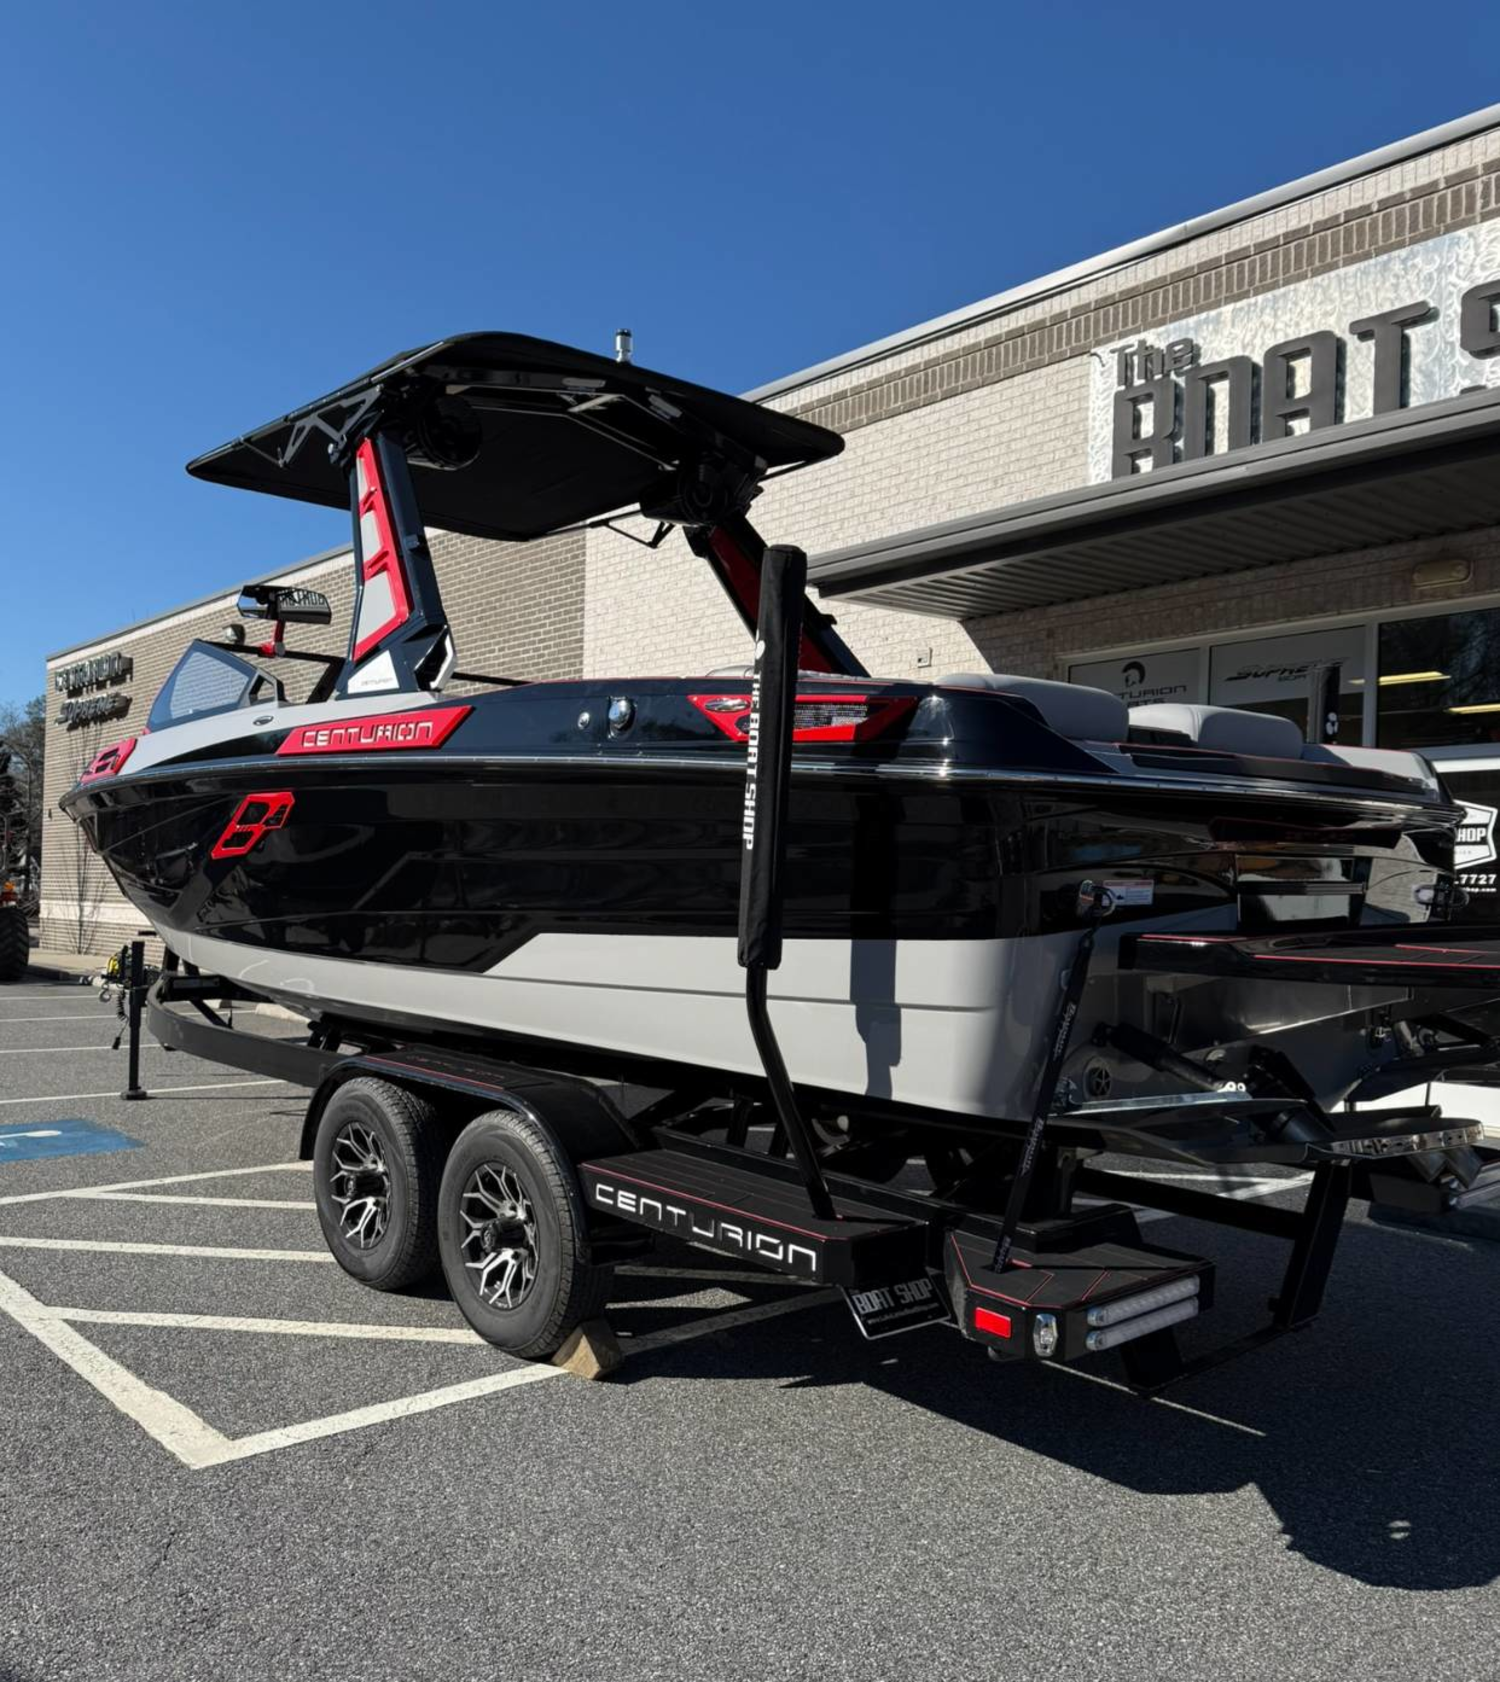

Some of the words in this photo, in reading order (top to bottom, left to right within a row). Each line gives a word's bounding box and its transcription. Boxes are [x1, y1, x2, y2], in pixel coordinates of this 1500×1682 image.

[1111, 338, 1199, 386] The
[302, 721, 434, 748] CENTURION
[747, 713, 760, 776] BOAT
[743, 783, 757, 850] SHOP
[1454, 827, 1487, 843] HOP
[595, 1183, 817, 1272] CENTURION
[851, 1287, 896, 1315] BOAT
[893, 1278, 934, 1304] SHOP
